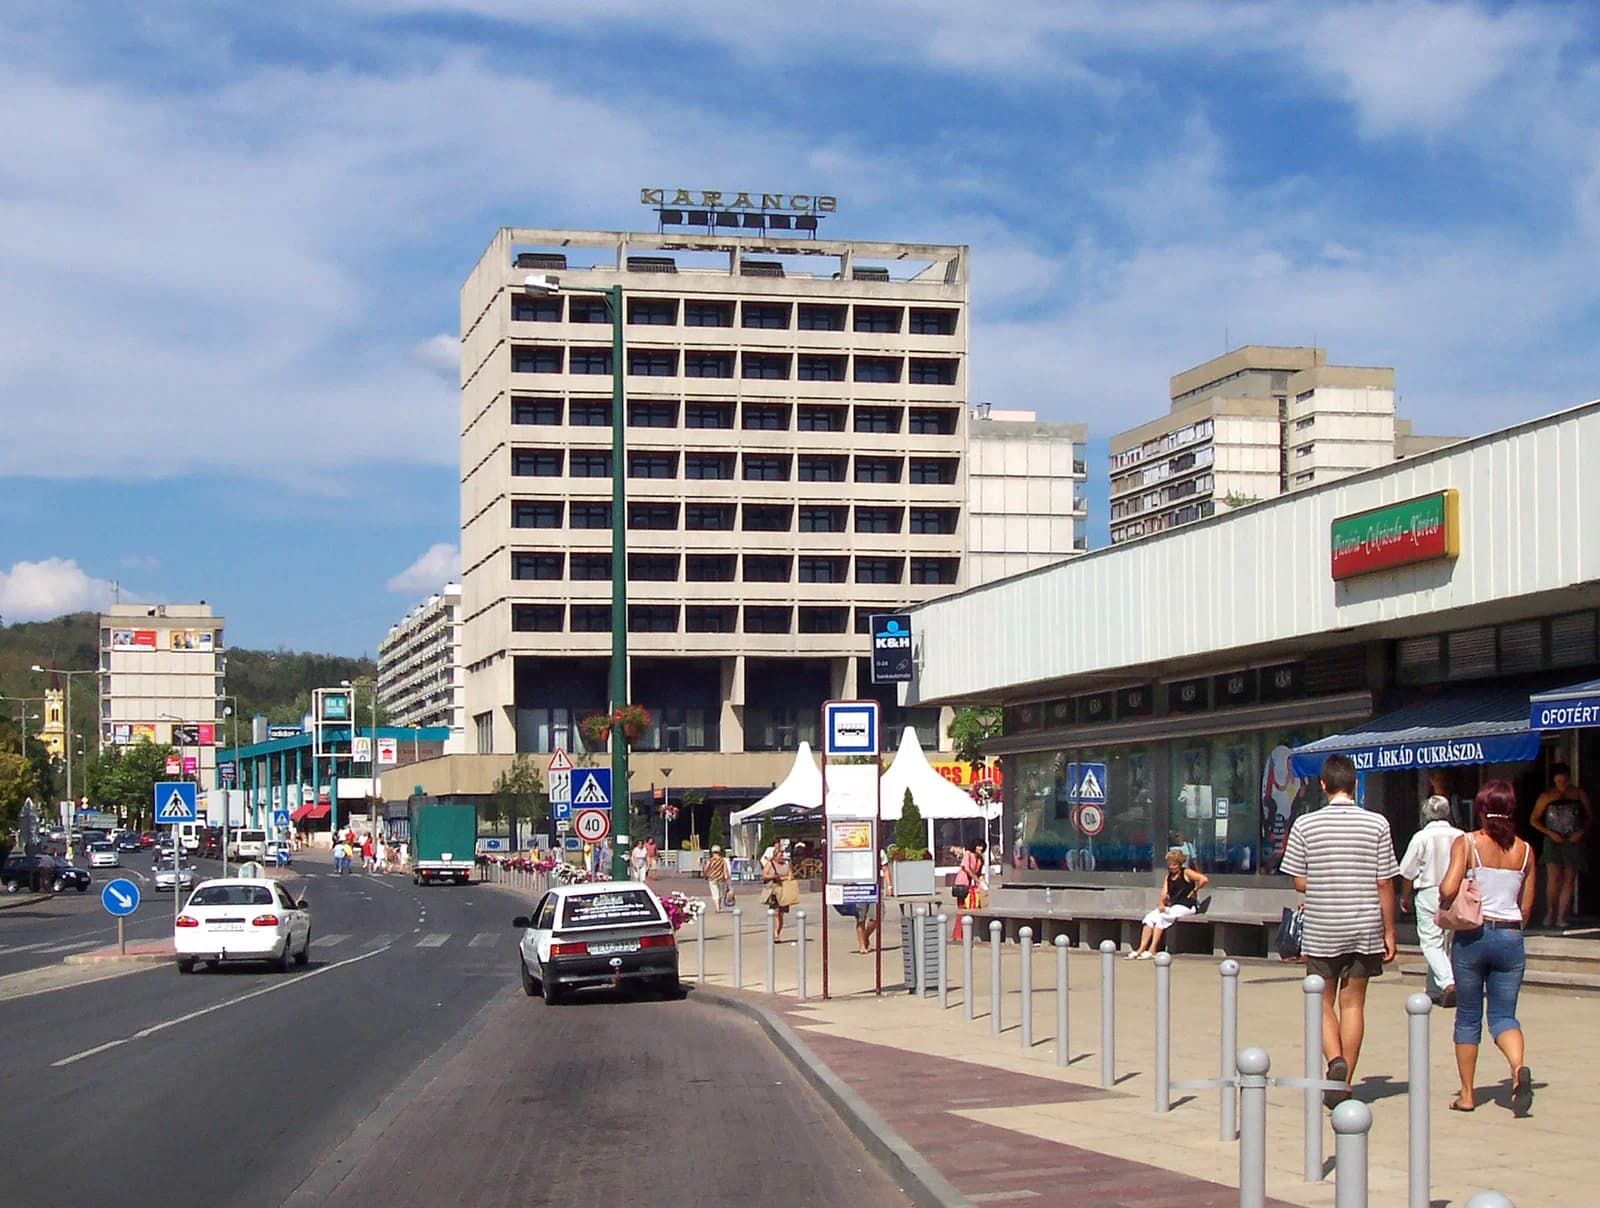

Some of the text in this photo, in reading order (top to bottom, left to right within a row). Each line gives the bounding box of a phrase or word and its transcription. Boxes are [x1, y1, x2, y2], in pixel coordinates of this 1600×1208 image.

[640, 188, 837, 212] KARANCS
[876, 637, 910, 649] K&H
[1541, 702, 1600, 725] OFOTÉRT
[1377, 745, 1413, 768] ÁRKÁD
[1416, 740, 1484, 764] CUKRÁSZDA
[557, 804, 568, 817] P
[585, 819, 600, 832] 40
